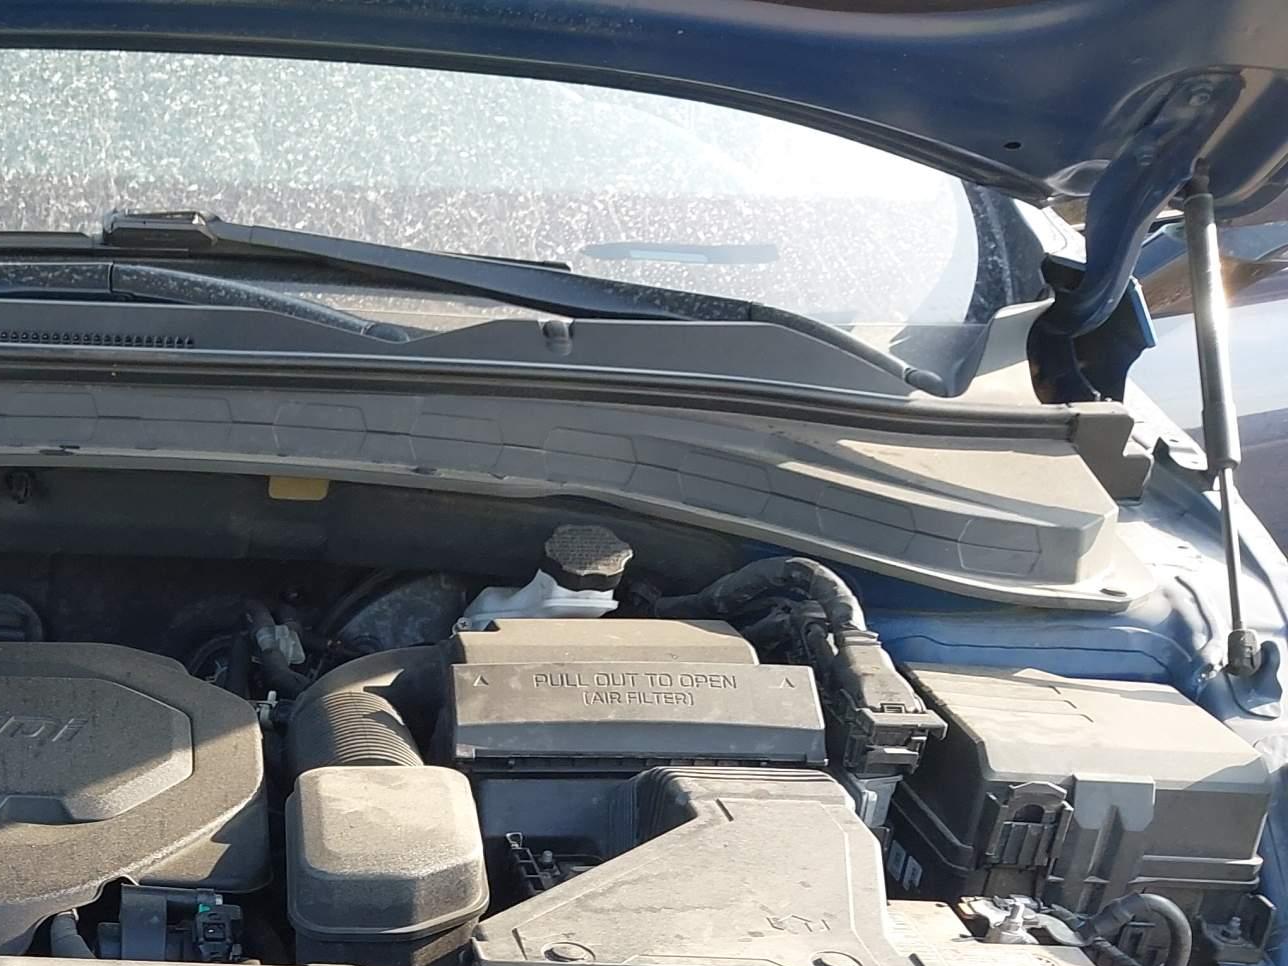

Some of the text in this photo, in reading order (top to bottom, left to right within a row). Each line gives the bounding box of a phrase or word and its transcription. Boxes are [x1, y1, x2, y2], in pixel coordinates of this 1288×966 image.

[533, 672, 737, 689] PULL OUT TO OPEN
[582, 691, 695, 707] (AIR FILTER)
